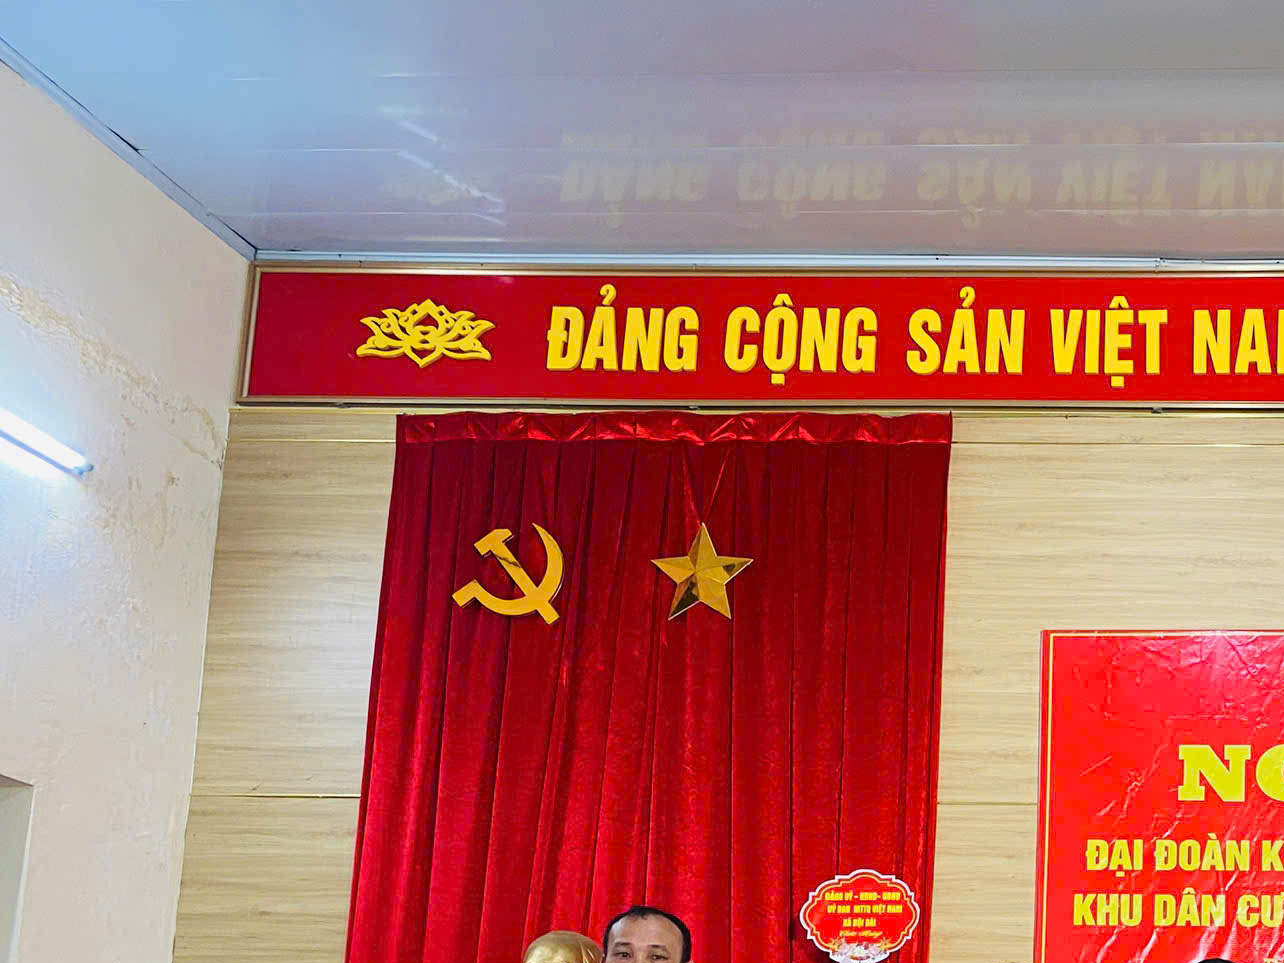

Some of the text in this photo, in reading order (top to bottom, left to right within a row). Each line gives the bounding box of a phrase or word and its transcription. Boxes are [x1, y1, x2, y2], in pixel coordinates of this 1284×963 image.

[547, 284, 698, 371] ĐẢNG
[725, 294, 877, 385] CỘNG
[907, 286, 1025, 374] SẢN
[1051, 295, 1167, 388] VIỆT
[1086, 840, 1143, 877] ĐẠI
[1154, 832, 1250, 872] ĐOÀN
[1073, 893, 1142, 927] KHU
[1154, 888, 1226, 927] DÂN
